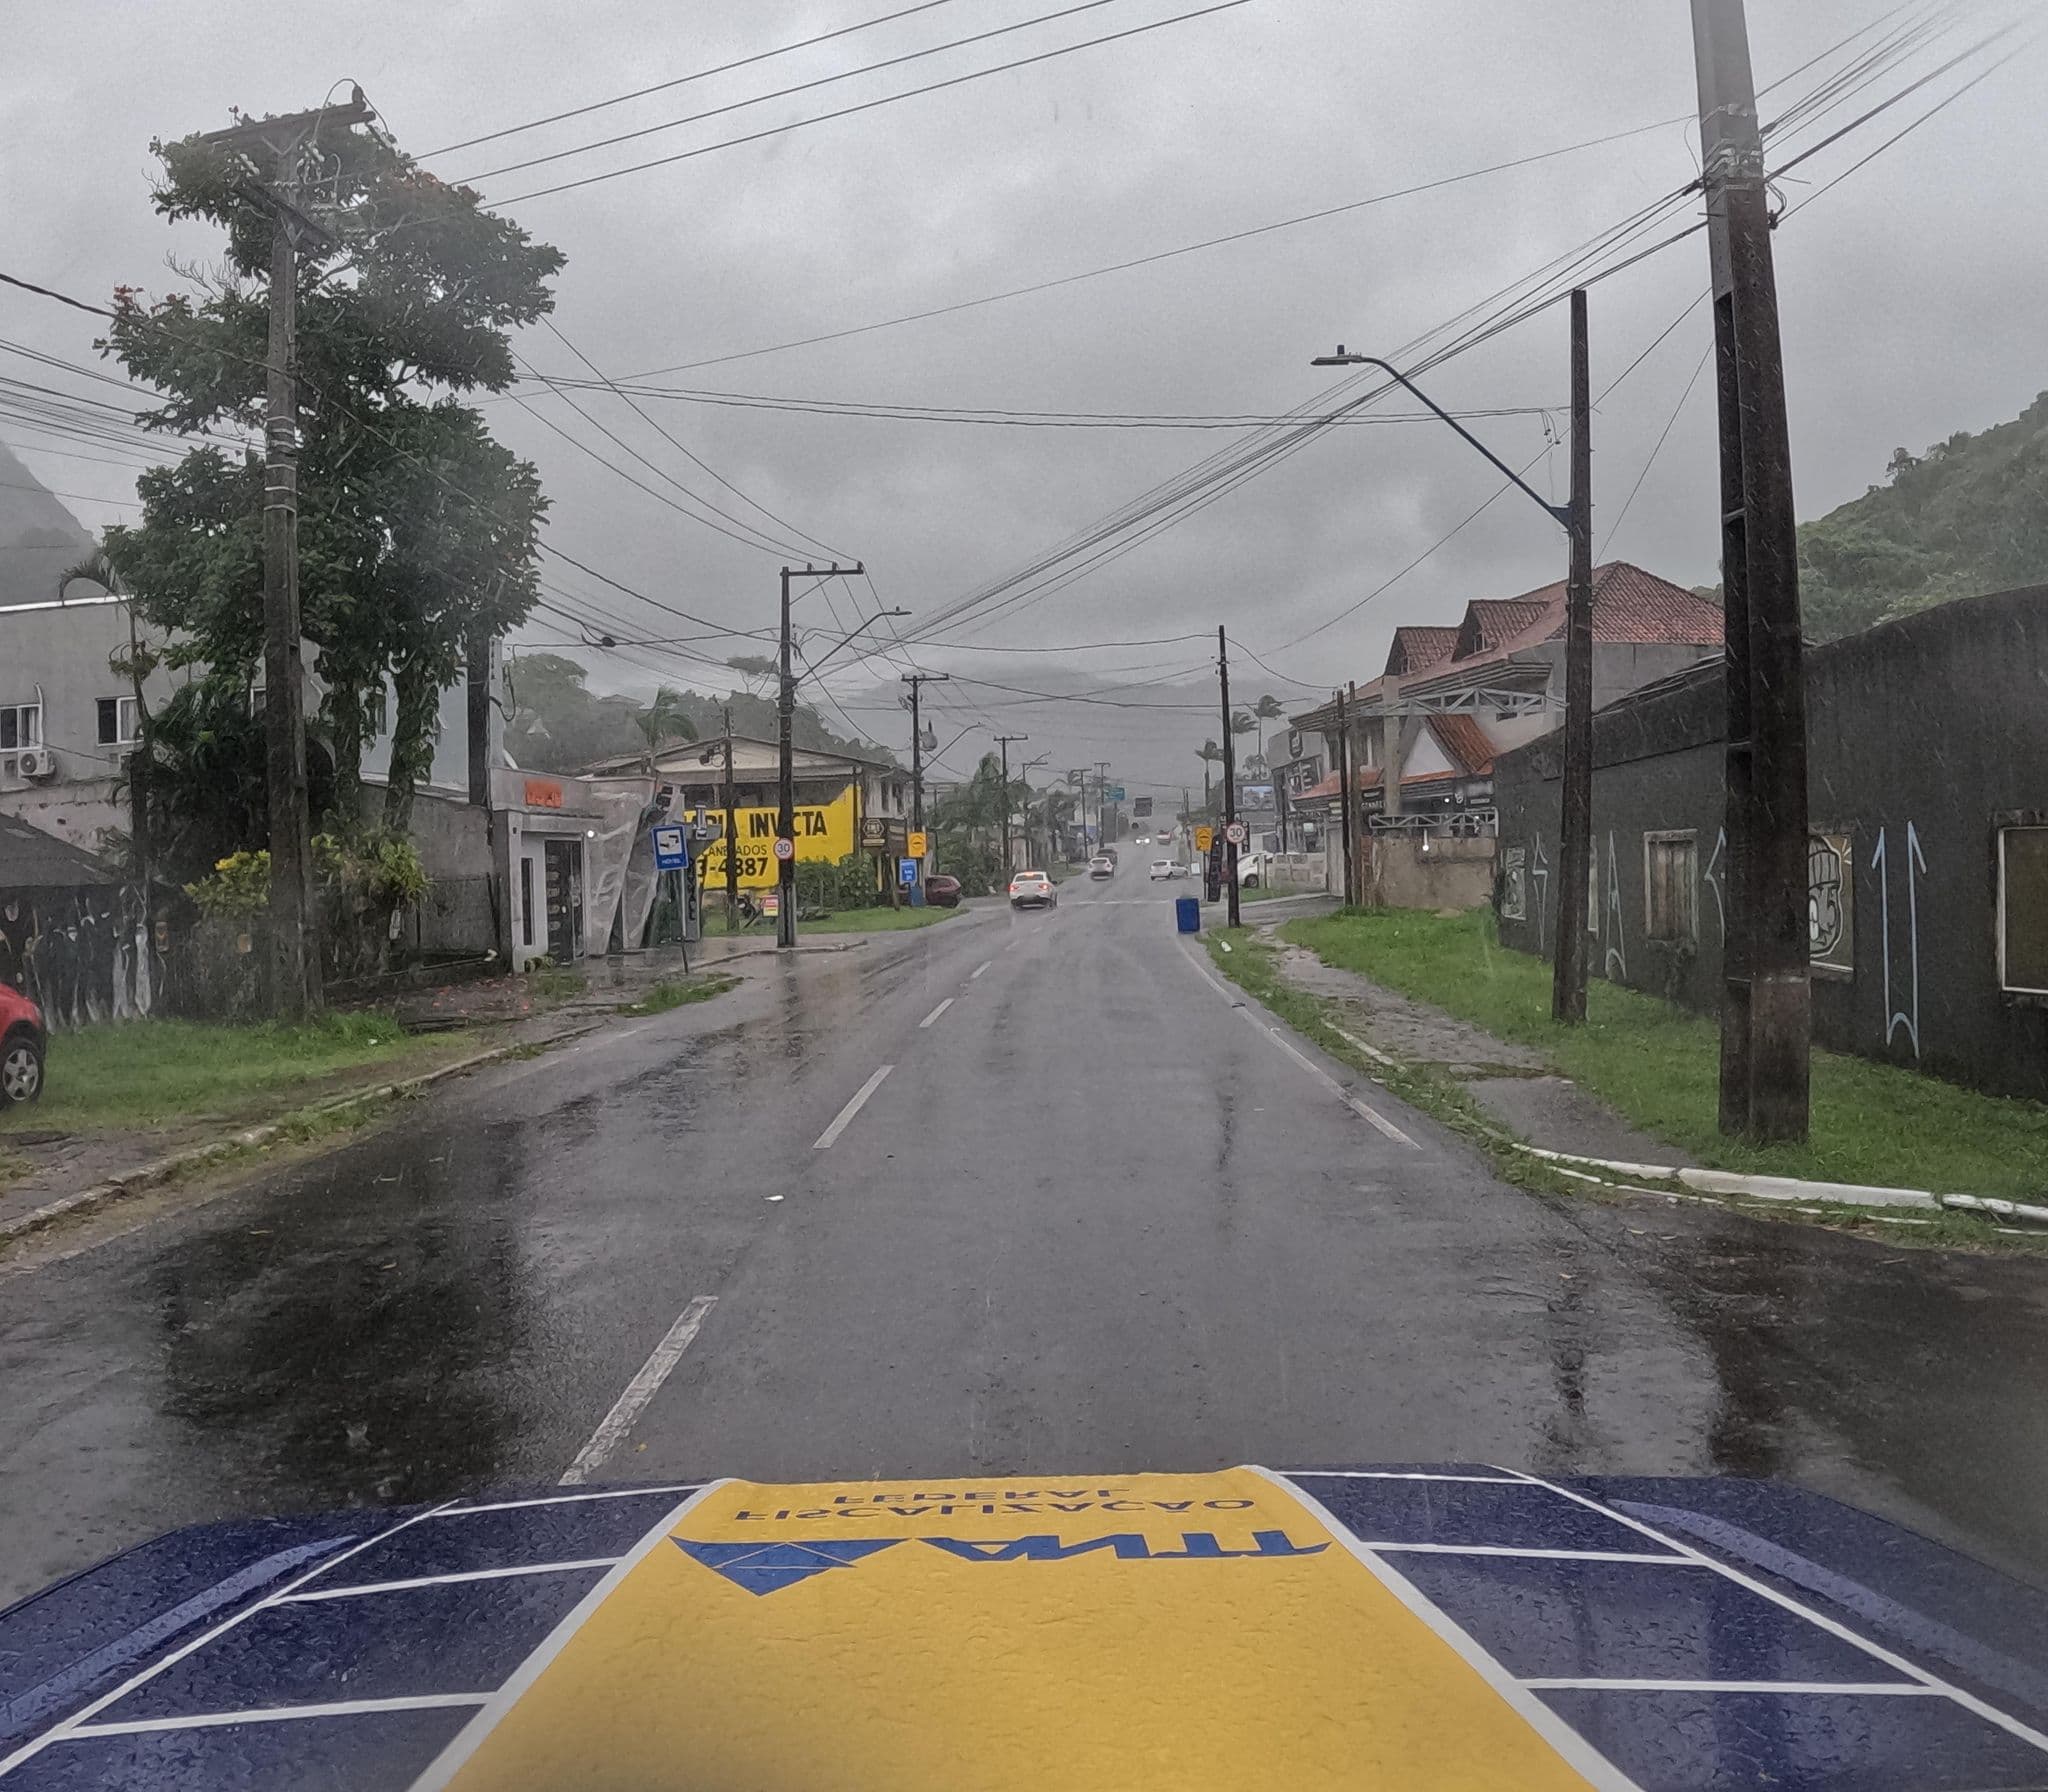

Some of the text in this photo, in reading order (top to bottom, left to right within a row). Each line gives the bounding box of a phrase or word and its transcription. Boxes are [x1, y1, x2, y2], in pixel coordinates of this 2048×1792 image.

[749, 811, 828, 838] INVCTA
[1229, 827, 1243, 838] 30
[777, 842, 791, 853] 30
